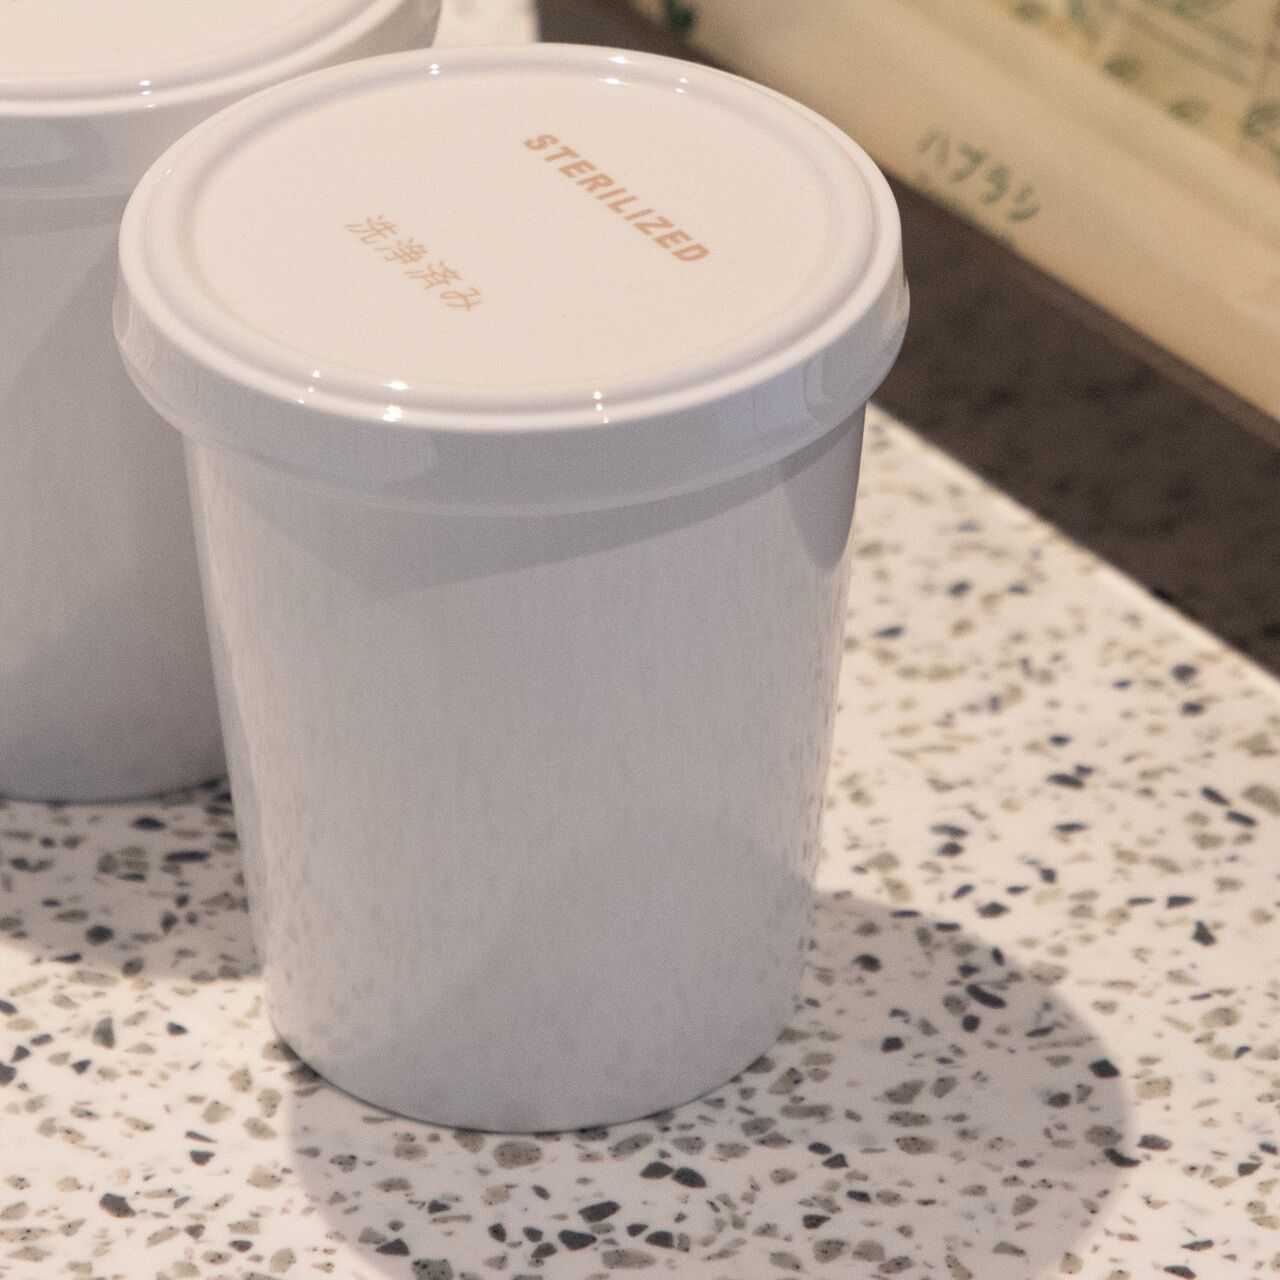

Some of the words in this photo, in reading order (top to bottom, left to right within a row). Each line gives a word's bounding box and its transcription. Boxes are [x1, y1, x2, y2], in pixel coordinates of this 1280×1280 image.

[522, 133, 711, 264] STERILIZED
[916, 128, 1041, 222] ハブラシ
[344, 214, 484, 312] 洗浄済み
